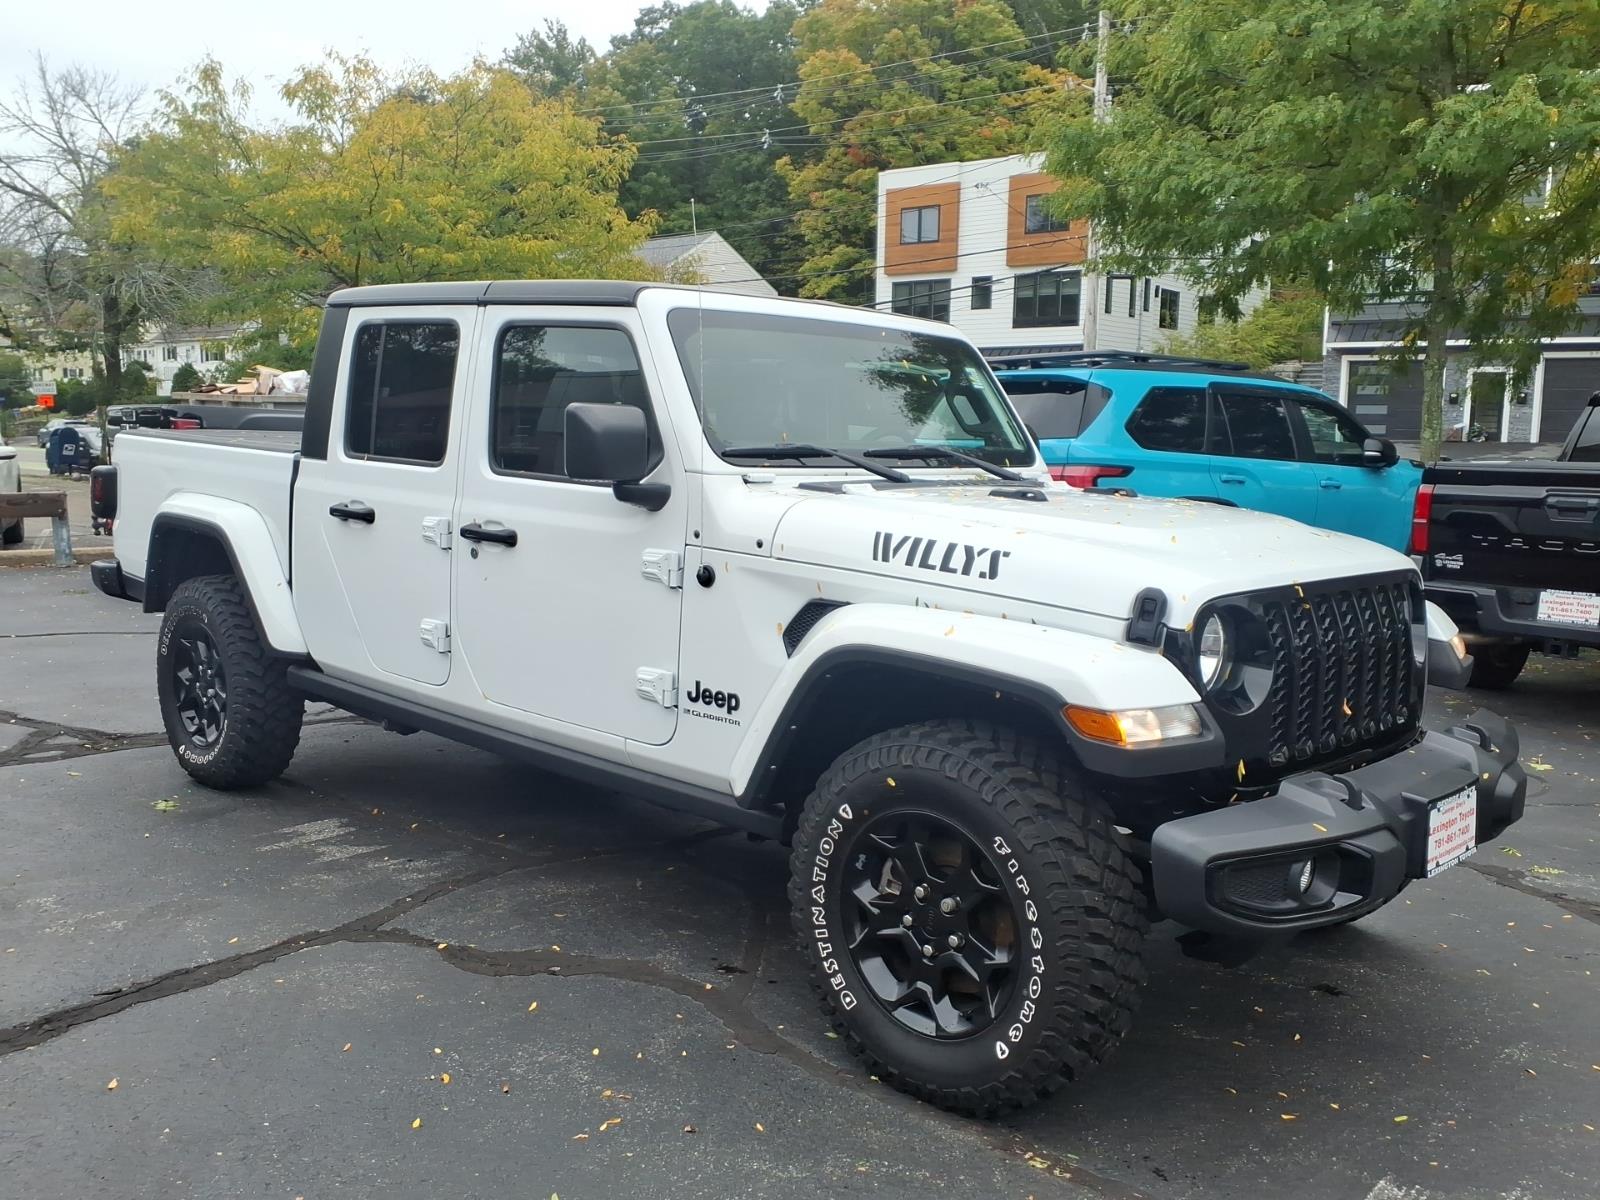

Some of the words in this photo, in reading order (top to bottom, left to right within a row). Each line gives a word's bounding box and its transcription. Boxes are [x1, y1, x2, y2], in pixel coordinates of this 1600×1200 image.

[872, 530, 1012, 581] WILLYS
[1541, 598, 1575, 607] Lexington
[1575, 601, 1599, 609] Toyota
[686, 679, 741, 715] Jeep
[691, 709, 741, 727] GLADIATOR
[1427, 816, 1458, 837] Lexington
[1458, 807, 1475, 824] Toyota
[1428, 856, 1460, 878] LEXINGTON
[811, 818, 858, 1011] DESTINATION
